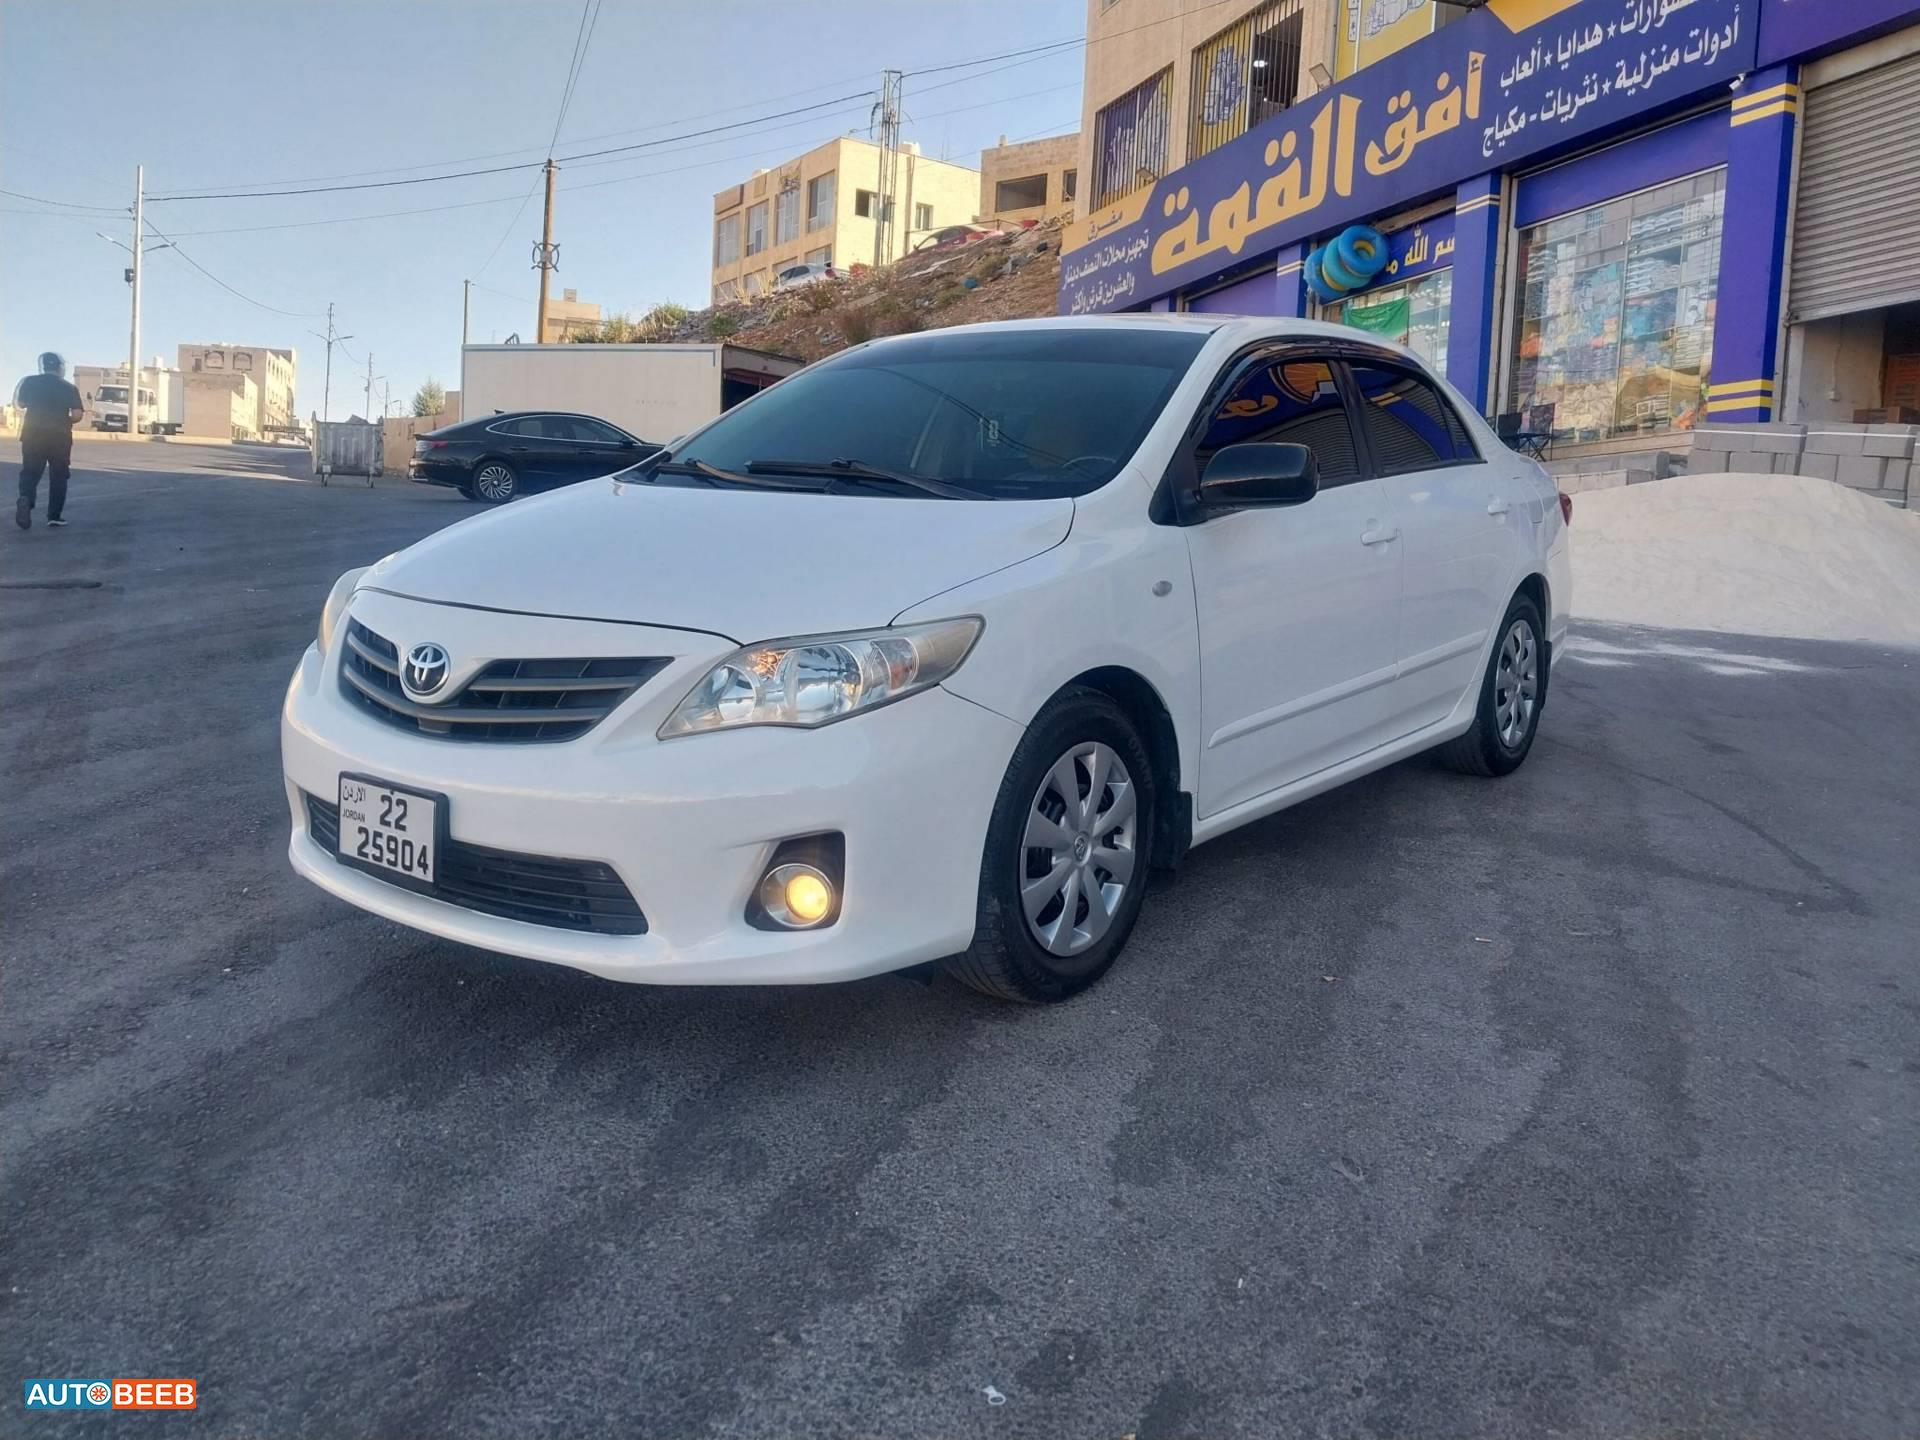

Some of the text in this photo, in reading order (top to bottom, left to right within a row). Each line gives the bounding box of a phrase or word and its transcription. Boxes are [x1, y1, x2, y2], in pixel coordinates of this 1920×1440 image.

[1500, 37, 1542, 96] ألعاب
[1557, 23, 1603, 70] هدايا
[1482, 4, 1740, 157] أدوات منزلية نثريات مكياج
[1152, 51, 1486, 275] أفق القمة
[1125, 229, 1149, 263] تجهيز
[1404, 224, 1429, 266] الله
[343, 808, 366, 823] JORDAN
[380, 795, 408, 832] 22
[357, 826, 429, 875] 25904
